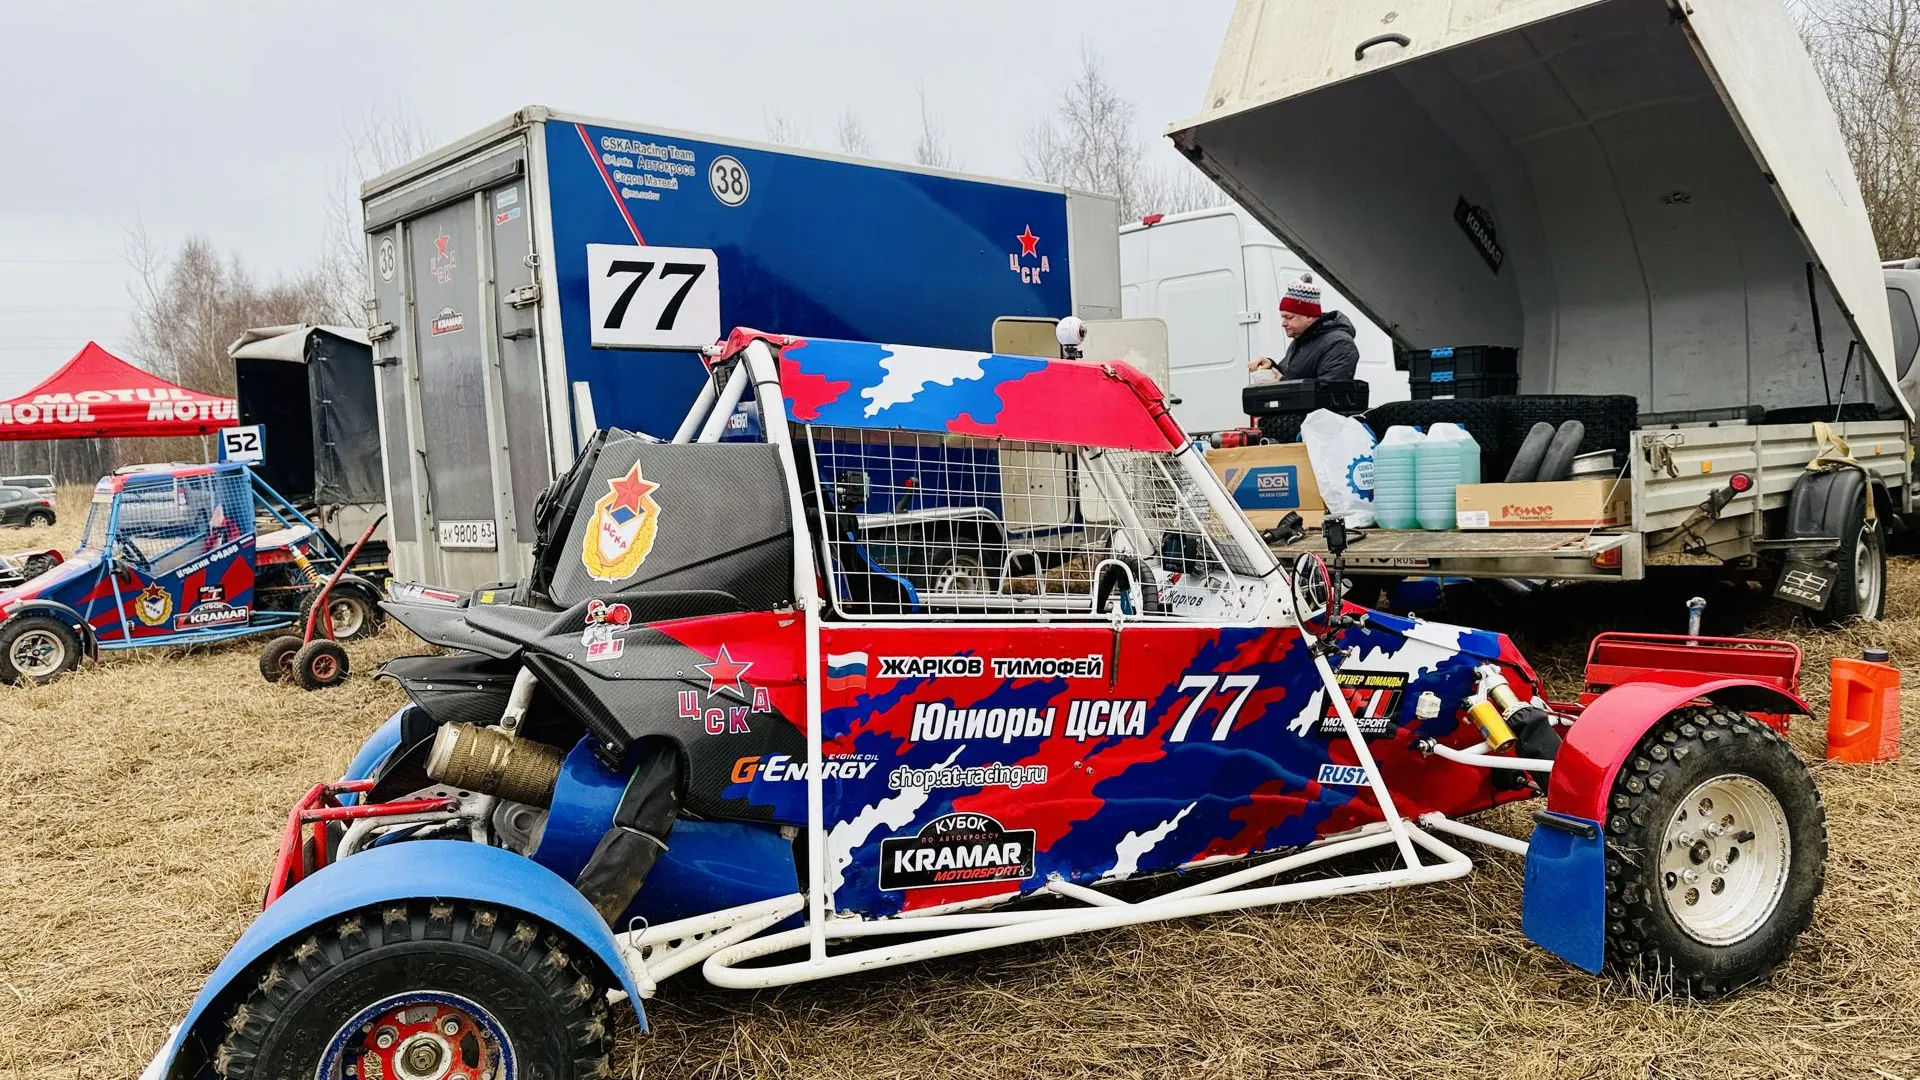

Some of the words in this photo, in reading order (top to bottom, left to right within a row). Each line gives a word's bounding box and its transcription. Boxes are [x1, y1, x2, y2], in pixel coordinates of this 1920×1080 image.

[601, 137, 633, 153] CSKA
[633, 142, 668, 160] Racing
[669, 146, 695, 161] Team
[637, 157, 695, 176] Автокросс
[614, 170, 644, 186] Седов
[645, 174, 678, 190] Матвей
[716, 165, 743, 196] 38
[380, 244, 394, 274] 38
[1009, 253, 1050, 284] ЦСКА
[603, 260, 706, 331] 77
[32, 388, 193, 404] MOTUL
[226, 433, 259, 453] 52
[1257, 476, 1289, 489] NEXEN
[454, 525, 478, 543] 9808
[481, 523, 492, 538] 63
[603, 522, 627, 549] ЦСКА
[190, 608, 247, 624] KRAMAR
[879, 657, 983, 677] ЖАРКОВ
[993, 655, 1103, 677] ТИМОФЕЙ
[1335, 674, 1365, 686] АРТНЕР
[1365, 676, 1404, 688] КОМАНДЫ
[678, 687, 772, 735] ЦСКА
[1169, 675, 1260, 742] 77
[910, 702, 1057, 744] Юниоры
[1065, 700, 1148, 741] ЦСКА
[1320, 717, 1391, 728] MOTSPORT
[731, 756, 877, 784] G-ENRGY
[889, 763, 1047, 793] shop.at-racing.ru
[935, 816, 988, 835] КУБОК
[921, 836, 934, 844] ПО
[939, 832, 1000, 843] АВТОКРОССУ
[894, 842, 1022, 874] KRAMAR
[934, 865, 1021, 882] MOTORSPORT
